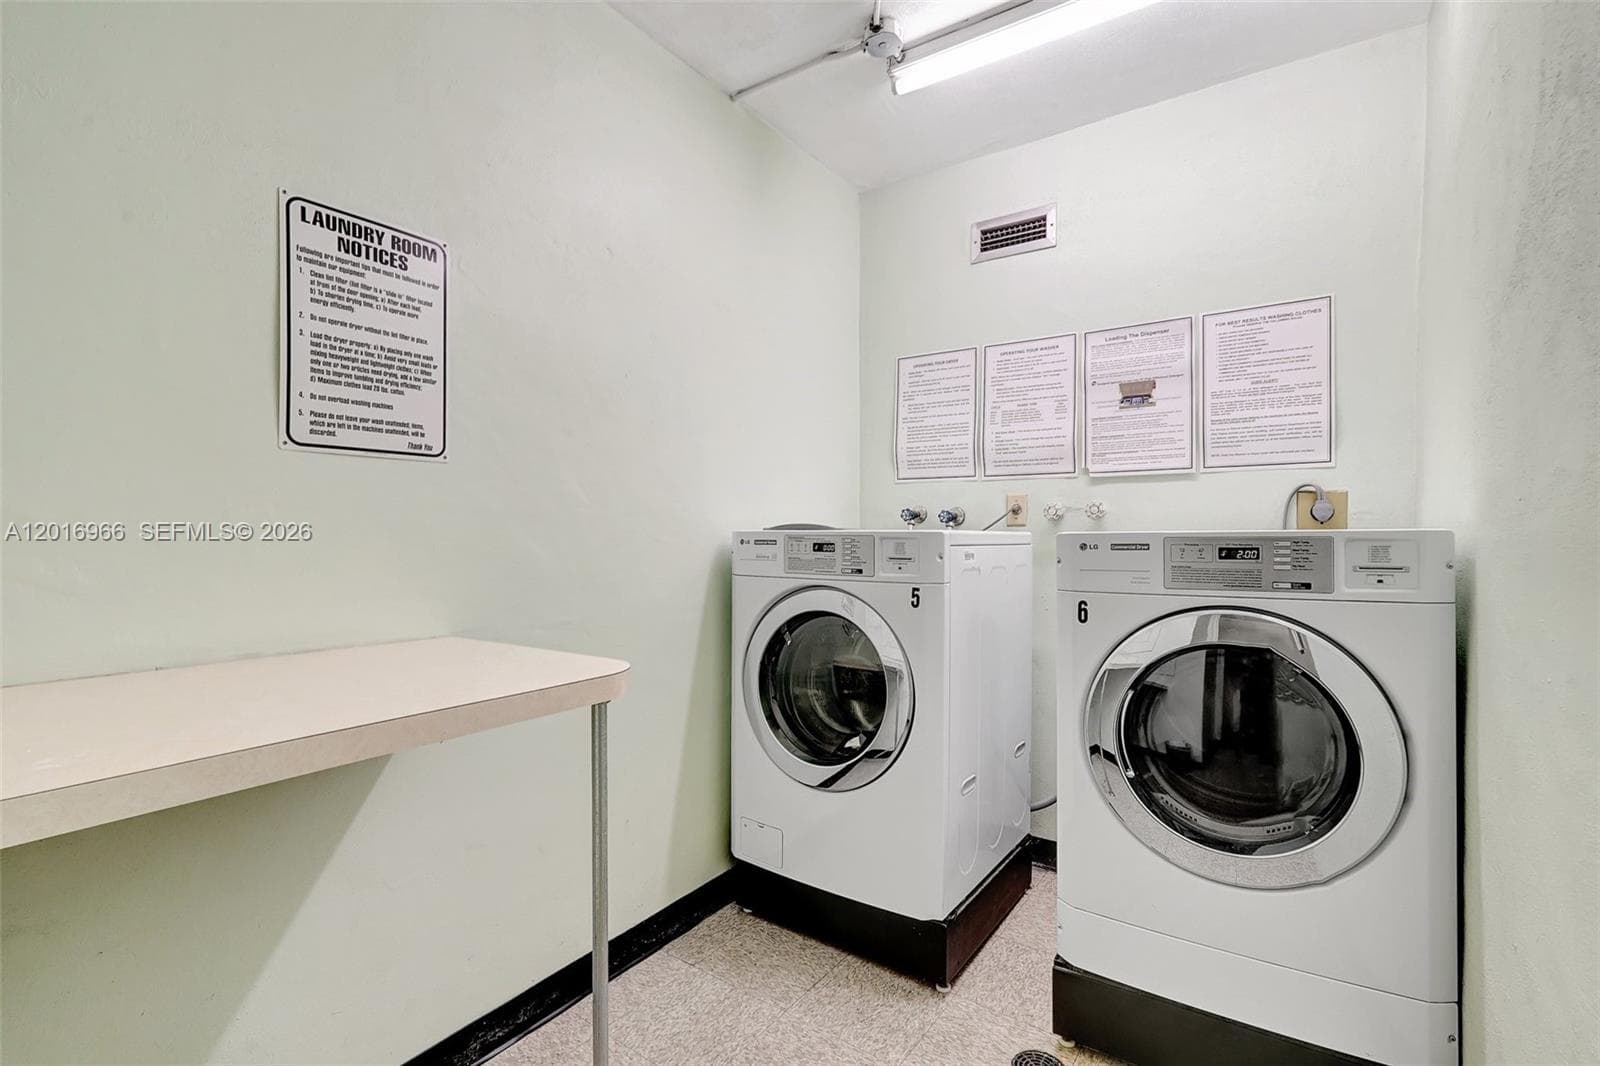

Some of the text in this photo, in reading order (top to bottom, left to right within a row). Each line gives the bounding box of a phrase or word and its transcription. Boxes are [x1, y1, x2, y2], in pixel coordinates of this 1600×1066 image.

[300, 205, 437, 263] LAUNDRY ROOM
[337, 235, 408, 272] NOTICES
[1140, 328, 1170, 336] Dispenser
[911, 587, 920, 608] 5
[1078, 600, 1088, 624] 6
